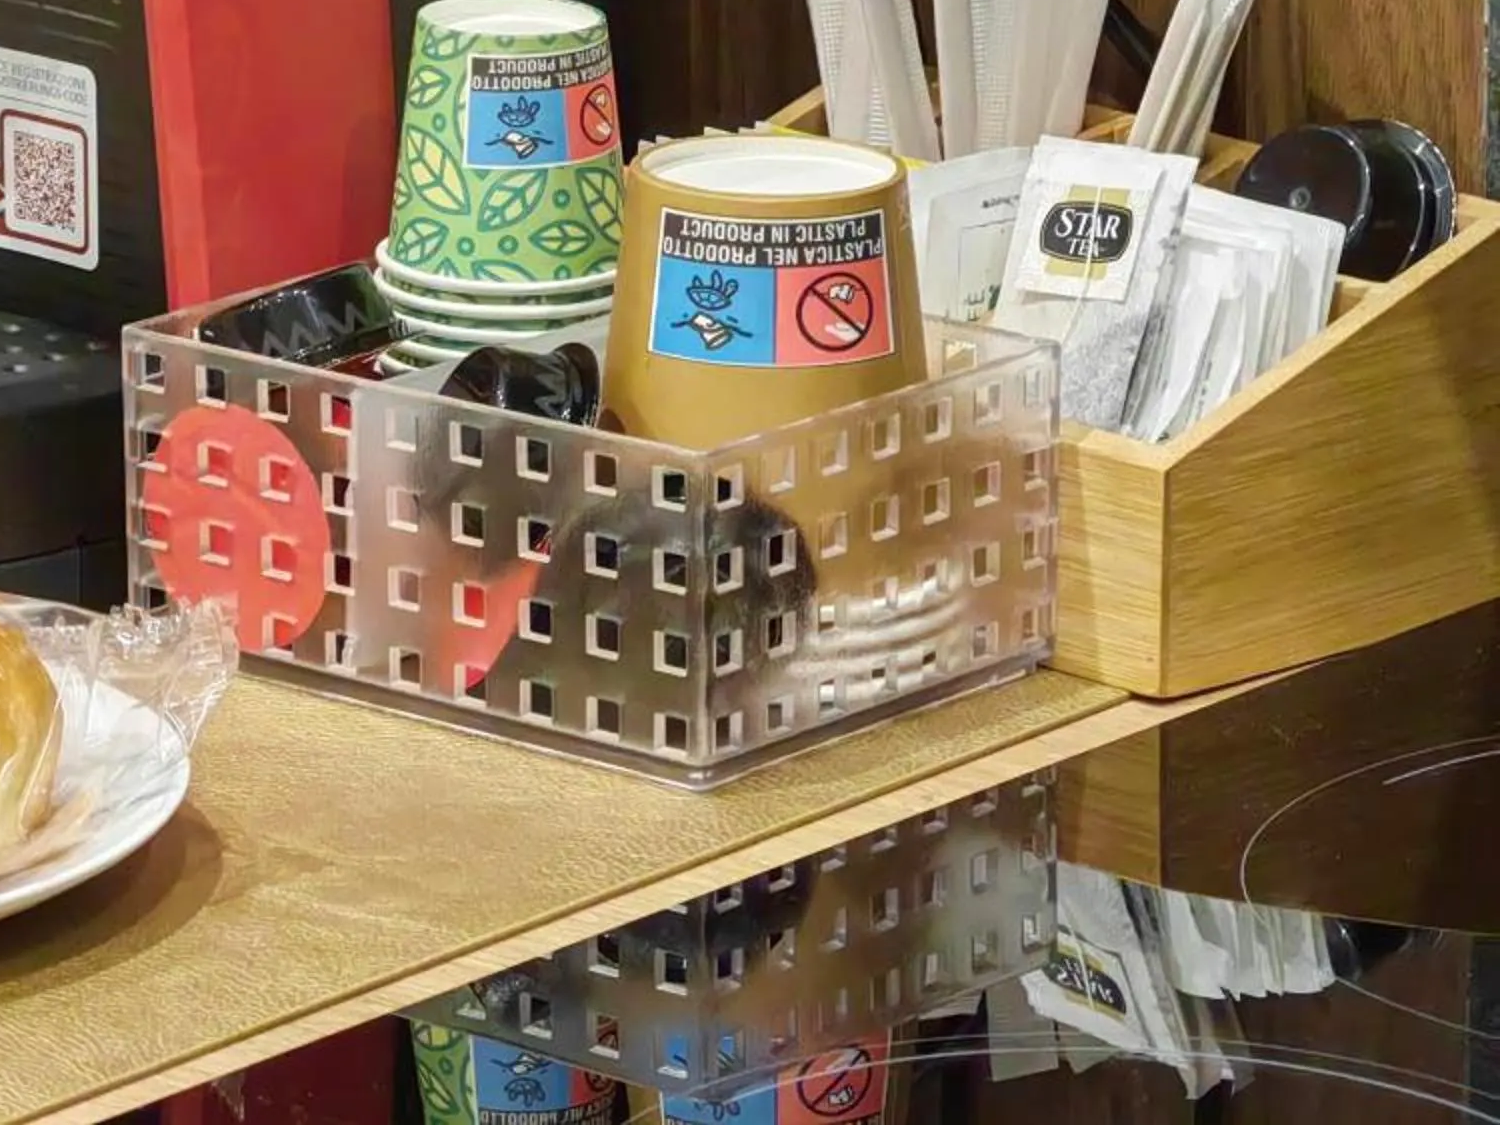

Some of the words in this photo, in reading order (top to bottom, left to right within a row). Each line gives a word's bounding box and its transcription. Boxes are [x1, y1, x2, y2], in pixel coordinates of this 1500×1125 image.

[488, 58, 556, 74] PRODUCT
[560, 55, 573, 68] IN
[473, 75, 551, 91] PRODOTTO
[558, 70, 578, 86] NEL
[680, 219, 765, 243] PRODUCT
[796, 219, 866, 243] PLASTIC
[1054, 208, 1120, 240] STAR
[771, 225, 789, 243] IN
[663, 236, 757, 265] PRODOTTO
[762, 247, 798, 266] NEL
[804, 237, 884, 265] PLASTICA
